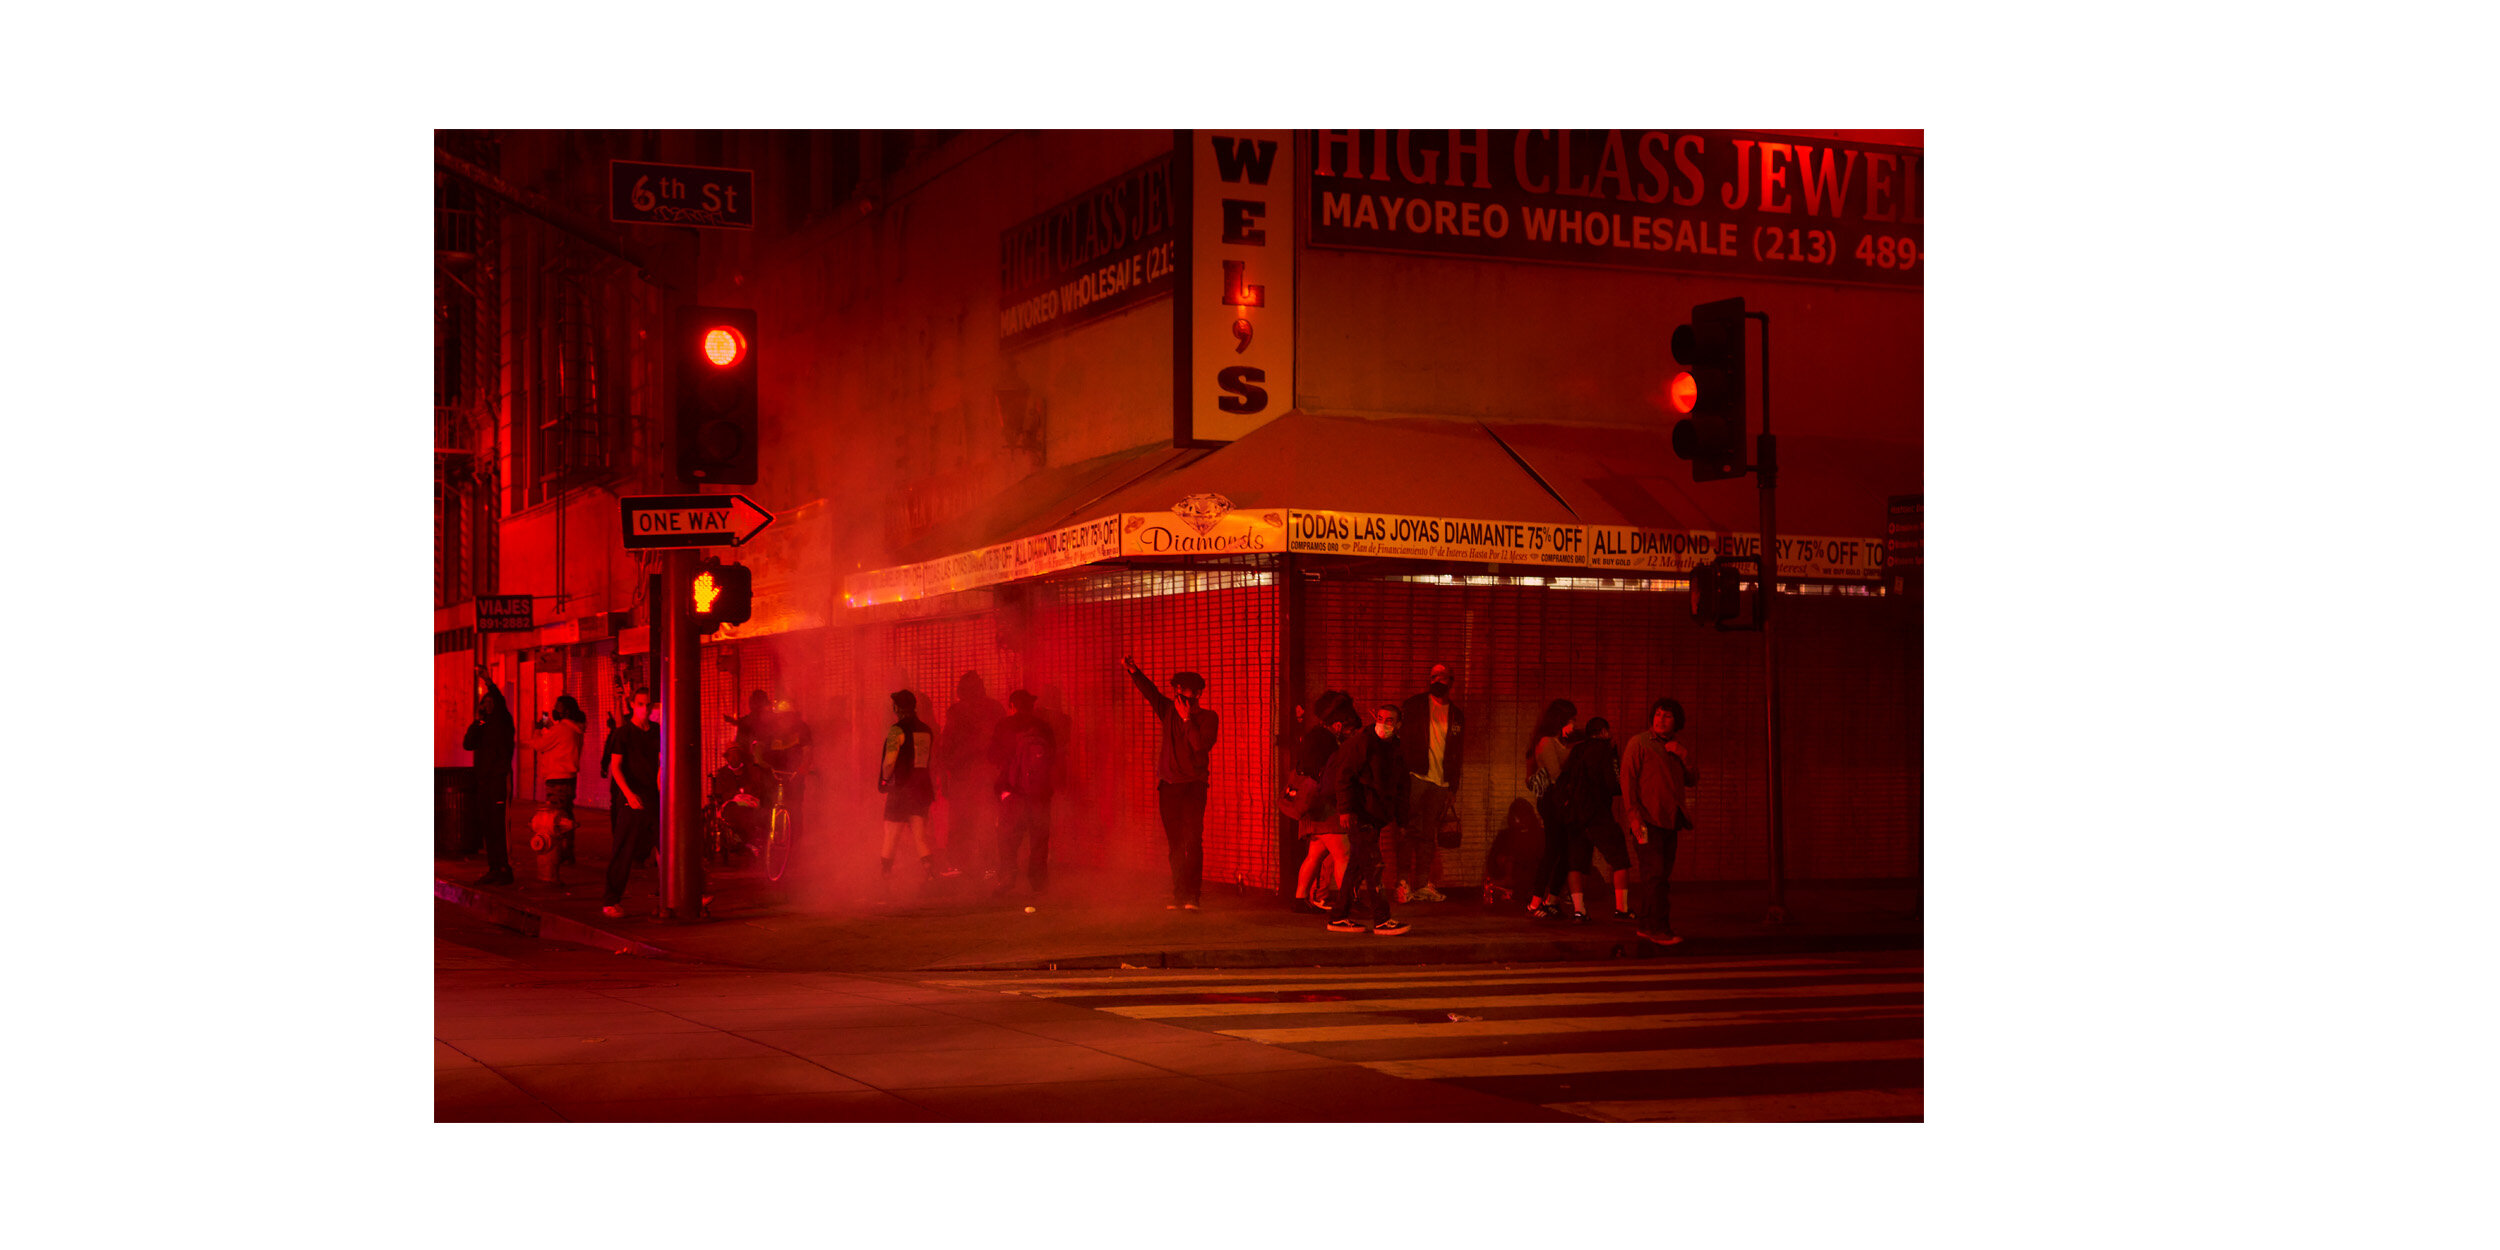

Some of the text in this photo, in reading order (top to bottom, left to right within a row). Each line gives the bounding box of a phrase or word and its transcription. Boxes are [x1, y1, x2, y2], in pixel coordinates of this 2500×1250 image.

[1314, 129, 1493, 190] HIGH
[1513, 129, 1706, 206] CLASS
[631, 174, 738, 213] 6th St
[1322, 192, 1510, 239] MAYOREO
[1522, 206, 1738, 256] WHOLESALE
[1752, 225, 1838, 267] (213)
[639, 511, 730, 532] ONE WAY
[1292, 513, 1583, 552] TODAS LAS JOYAS DIAMANTE 75% OFF
[1290, 541, 1339, 552] COMPRAMOS ORO
[1352, 542, 1367, 553] Plan
[1368, 542, 1377, 553] de
[1469, 548, 1488, 559] Hasta
[1489, 549, 1500, 560] Por
[1593, 530, 1859, 566] ALL DIAMOND JEWERY 75% OFF
[1541, 554, 1574, 563] COMPRAMOS
[1592, 557, 1601, 565] WE
[1615, 558, 1631, 566] GOLD
[479, 599, 530, 615] VIAJES
